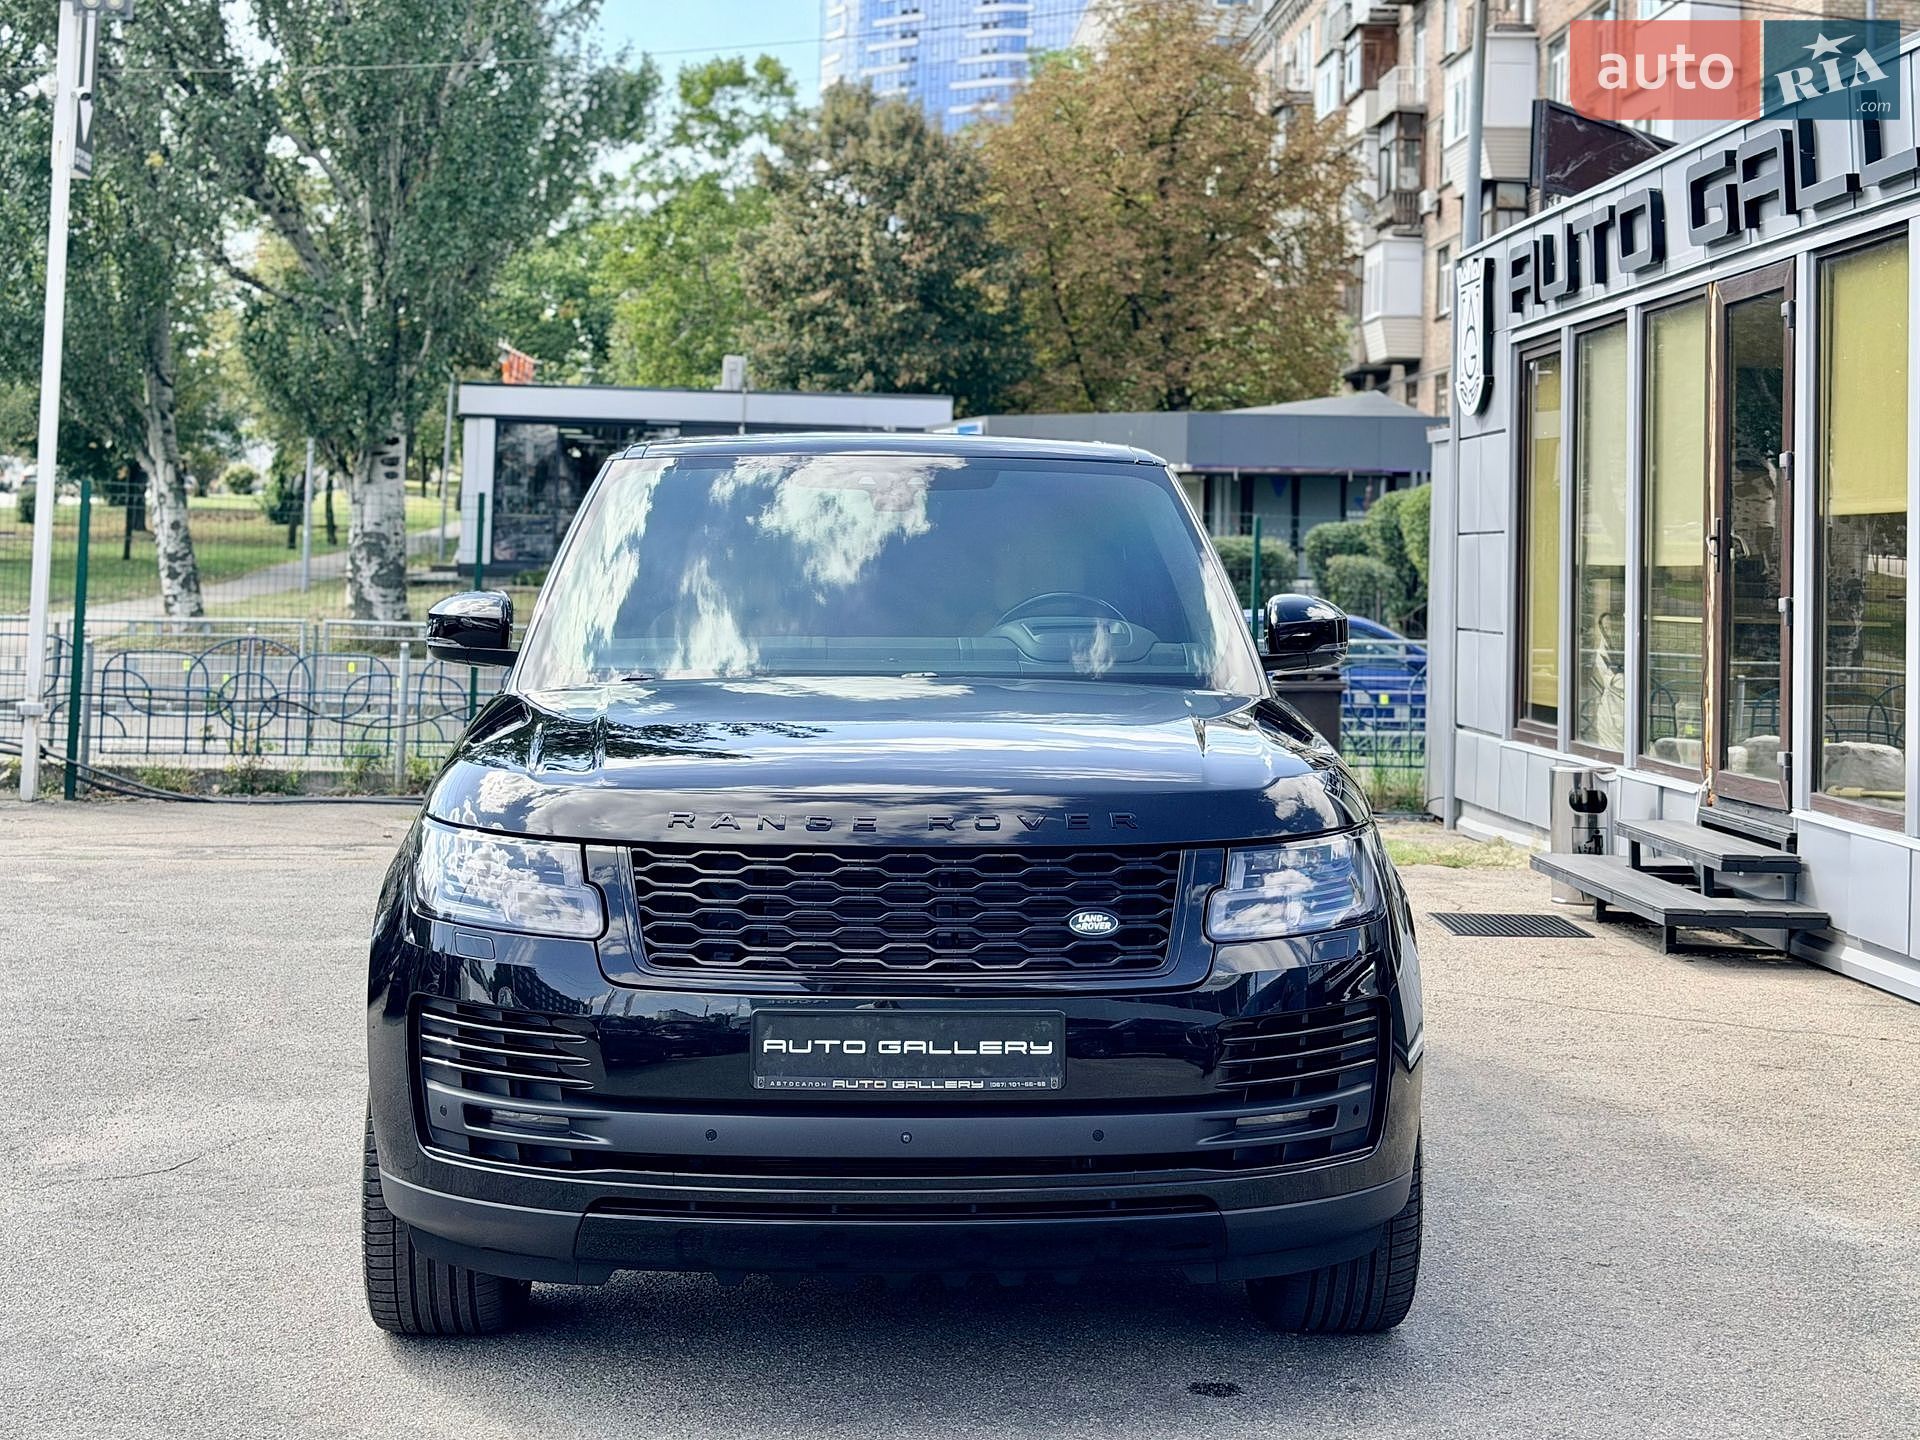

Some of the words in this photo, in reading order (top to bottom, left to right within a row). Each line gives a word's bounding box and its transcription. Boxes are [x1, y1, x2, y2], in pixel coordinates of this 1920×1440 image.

[1509, 188, 1665, 314] AUTO
[667, 811, 877, 833] RANGE
[927, 811, 1139, 833] ROVER
[1078, 914, 1102, 922] LAND
[1081, 921, 1112, 930] ROVER
[763, 1039, 866, 1055] AUTO
[878, 1040, 1053, 1055] GALLERY
[832, 1079, 886, 1089] AUTO
[892, 1079, 984, 1089] GALLERY
